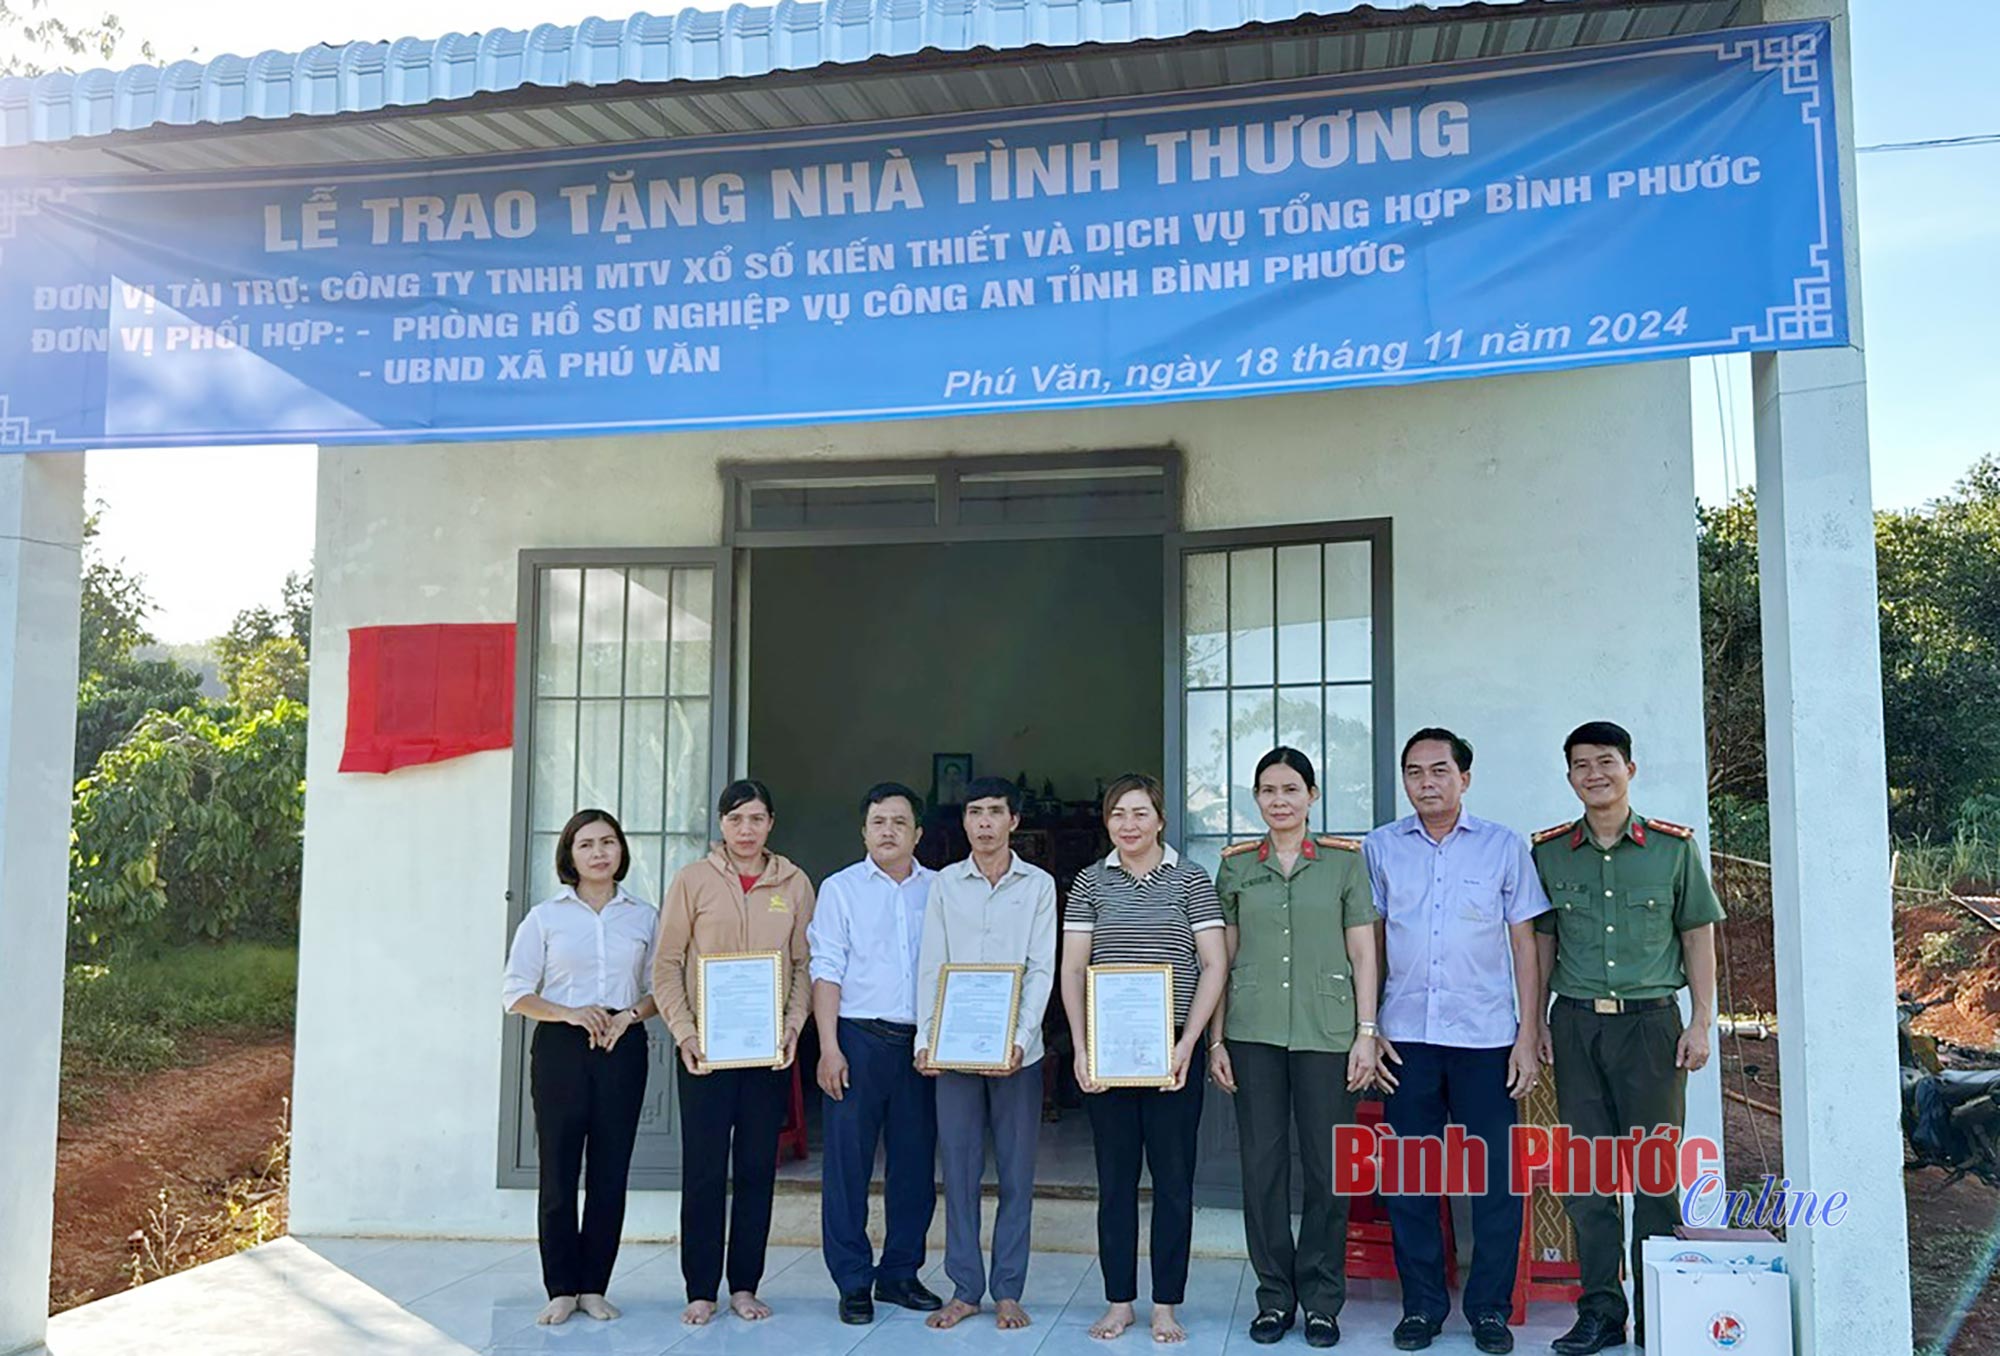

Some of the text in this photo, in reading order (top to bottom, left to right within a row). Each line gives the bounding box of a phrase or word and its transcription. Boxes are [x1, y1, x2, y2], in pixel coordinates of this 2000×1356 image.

[34, 154, 1761, 315] ĐƠN VỊ TÀI TRỢ: CÔNG TY TNHH MTV XỔ SỐ KIẾN THIẾT VÀ DỊCH VỤ TỔNG HỢP BÌNH PHƯỚC
[264, 100, 1470, 253] LỄ TRAO TẶNG NHÀ TÌNH THƯƠNG
[31, 326, 108, 353] ĐƠN
[120, 326, 153, 356] VỊ
[166, 315, 249, 352] PHỐI
[262, 318, 344, 352] HỢP:
[393, 308, 518, 341] PHÒNG
[532, 301, 580, 337] HỒ
[592, 303, 643, 334] SƠ
[654, 293, 789, 331] NGHIỆP
[802, 293, 850, 325] VỤ
[863, 283, 968, 317] CÔNG
[981, 278, 1034, 309] AN
[1047, 264, 1138, 305] TỈNH
[1152, 258, 1249, 296] BÌNH
[1264, 240, 1406, 284] PHƯỚC
[943, 306, 1688, 398] Phú Văn, ngày 18 tháng 11 năm 2024
[384, 356, 485, 385] UBND
[497, 350, 547, 381] XÃ
[559, 345, 634, 378] PHÚ
[646, 342, 720, 375] VĂN
